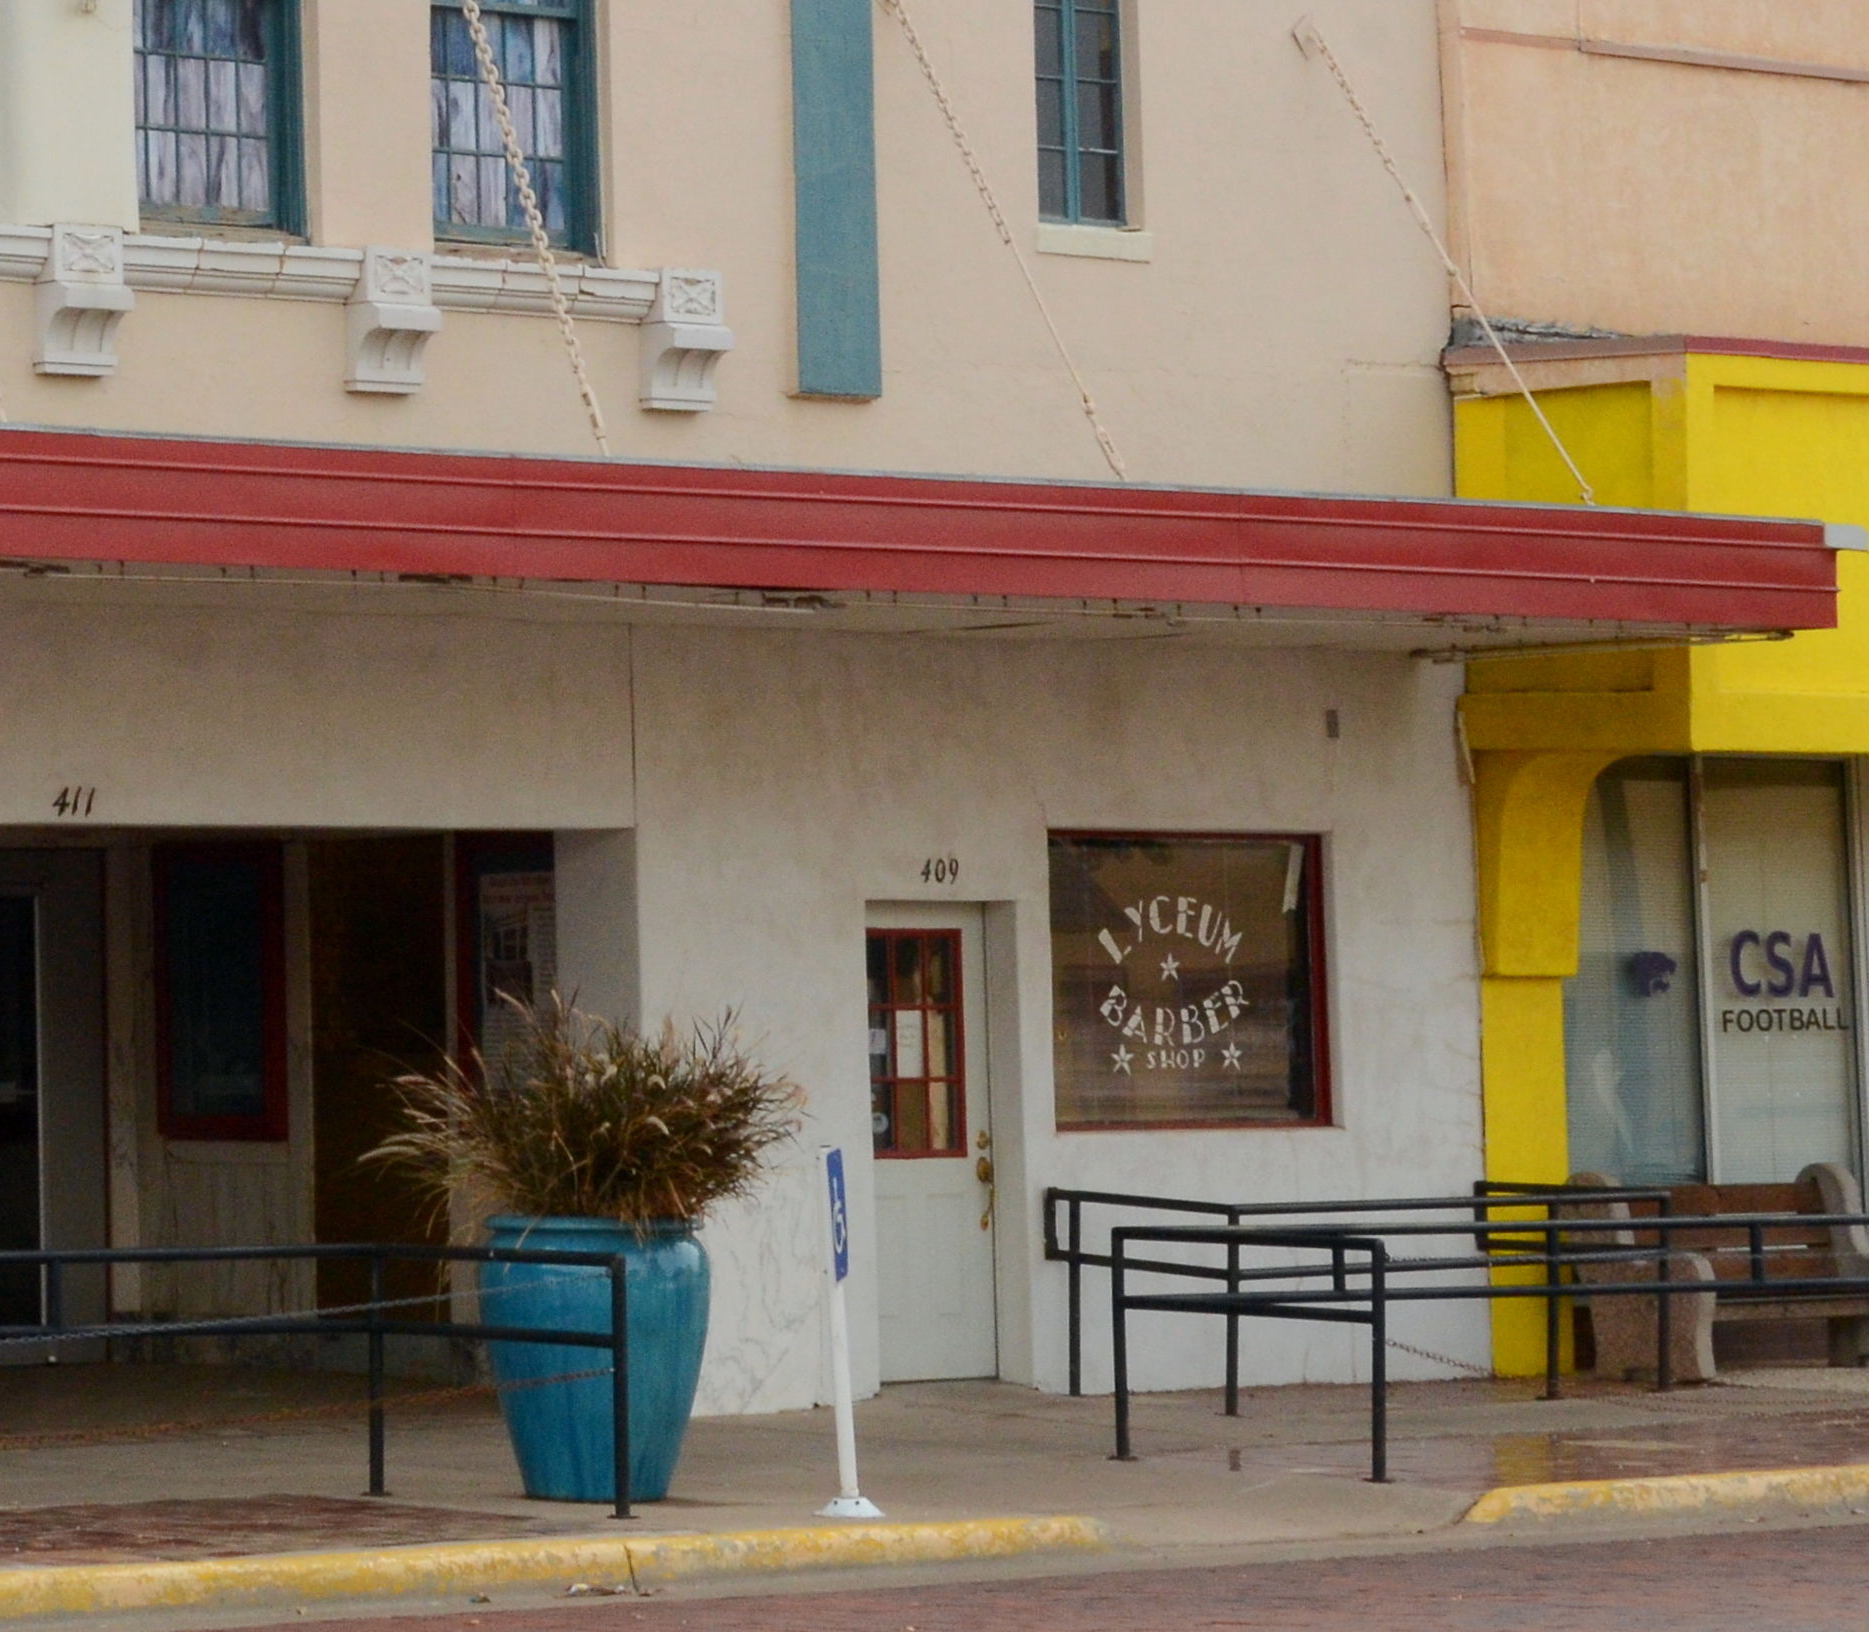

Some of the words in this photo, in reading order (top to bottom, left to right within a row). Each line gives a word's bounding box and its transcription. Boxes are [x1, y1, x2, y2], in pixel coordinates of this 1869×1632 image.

[52, 786, 96, 817] 411
[920, 857, 960, 885] 409
[1097, 894, 1244, 965] LYCEUM
[1730, 929, 1835, 999] CSA
[1099, 979, 1250, 1047] BARBER
[1721, 1007, 1850, 1033] FOOTBALL
[1145, 1047, 1206, 1070] SHOP
